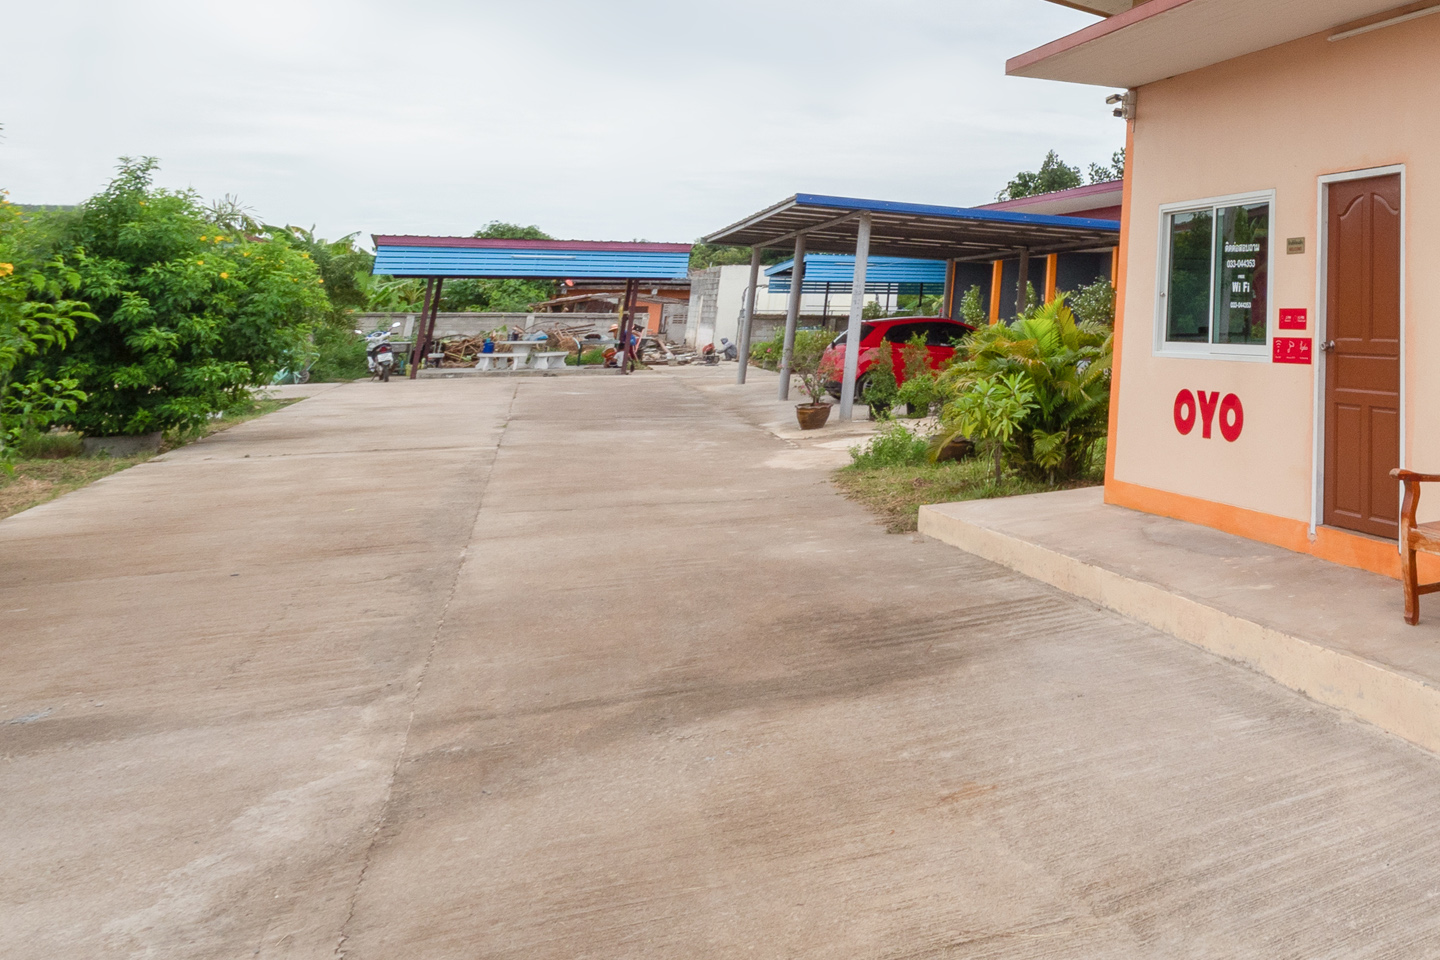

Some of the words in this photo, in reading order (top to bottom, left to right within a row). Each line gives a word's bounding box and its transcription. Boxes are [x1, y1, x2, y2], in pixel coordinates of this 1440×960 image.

[1232, 281, 1241, 293] Wi
[1243, 281, 1250, 293] Fi
[1174, 388, 1244, 442] OYO
